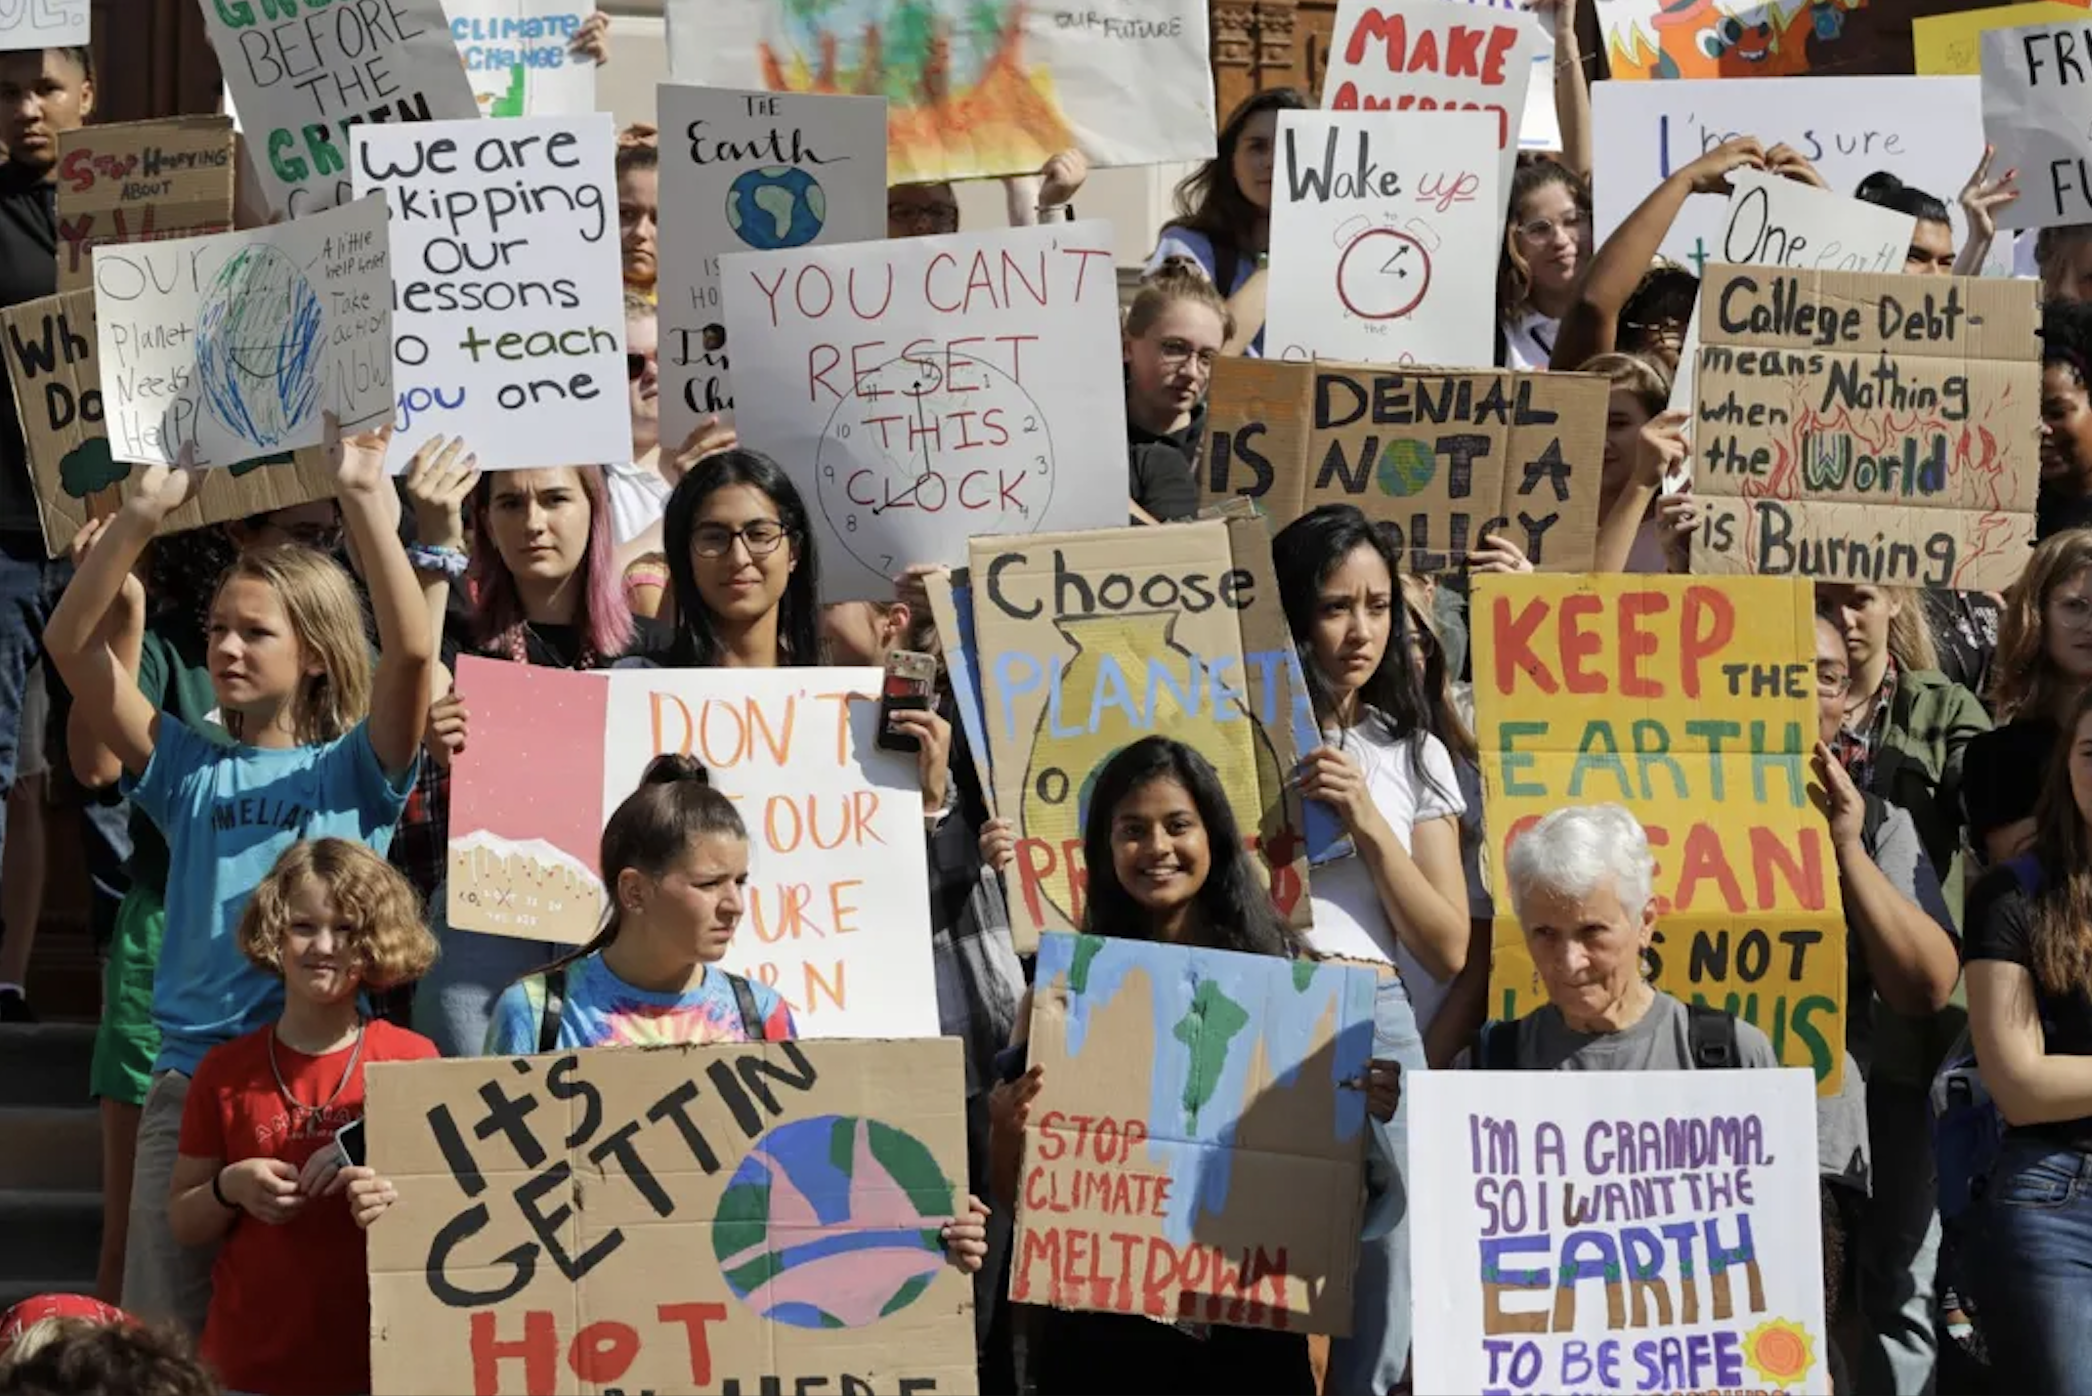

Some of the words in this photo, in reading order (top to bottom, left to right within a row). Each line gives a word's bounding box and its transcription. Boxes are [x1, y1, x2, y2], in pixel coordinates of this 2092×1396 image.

[239, 0, 424, 88] BEFORE
[1104, 17, 1181, 38] FUTURE
[1345, 8, 1518, 86] MAKE
[294, 56, 400, 116] THE
[741, 96, 782, 116] THE
[360, 138, 457, 181] We
[475, 132, 580, 172] are
[686, 120, 850, 165] Earth
[1286, 126, 1402, 203] Wake
[1415, 170, 1480, 212] up
[121, 181, 172, 201] ABOUT
[323, 237, 332, 259] A
[337, 230, 372, 260] little
[392, 279, 580, 313] lessons
[750, 263, 893, 328] YOU
[925, 239, 1112, 314] CAN'T
[111, 321, 193, 368] Planet
[459, 326, 619, 363] teach
[809, 336, 1039, 402] RESET
[1700, 346, 1825, 377] means
[116, 366, 191, 405] Needs
[393, 387, 466, 433] you
[496, 373, 600, 410] one
[1315, 374, 1560, 429] DENIAL
[1700, 390, 1789, 427] when
[836, 424, 851, 439] 10
[861, 408, 1009, 452] THIS
[1023, 416, 1039, 433] 2
[825, 465, 835, 484] 9
[1035, 455, 1050, 476] 3
[1209, 422, 1275, 498] IS
[1518, 437, 1571, 501] A
[1704, 435, 1772, 477] the
[1801, 431, 1949, 497] World
[847, 468, 1027, 512] CLOCK
[846, 515, 857, 533] 8
[1703, 504, 1736, 553] is
[1755, 500, 1957, 588] Burning
[986, 549, 1255, 620] Choose
[1492, 585, 1735, 699] KEEP
[1722, 662, 1809, 699] THE
[990, 649, 1287, 741] PLANET
[648, 688, 882, 769] DON'T
[1497, 719, 1806, 808] EARTH
[764, 790, 888, 854] OUR
[1688, 929, 1824, 984] NOT
[1038, 1111, 1149, 1163] STOP
[1469, 1113, 1520, 1176] I'M
[1534, 1121, 1567, 1177] A
[426, 1040, 819, 1308] GETTIN
[1025, 1165, 1174, 1218] CLIMATE
[1475, 1178, 1528, 1237] SO
[1537, 1182, 1548, 1231] I
[1562, 1176, 1676, 1228] WANT
[1680, 1168, 1755, 1212] THE
[1012, 1226, 1290, 1330] MELTDOWN
[1479, 1213, 1767, 1336] EARTH
[1482, 1339, 1543, 1388] TO
[1561, 1339, 1621, 1388] BE
[1633, 1331, 1743, 1390] SAFE
